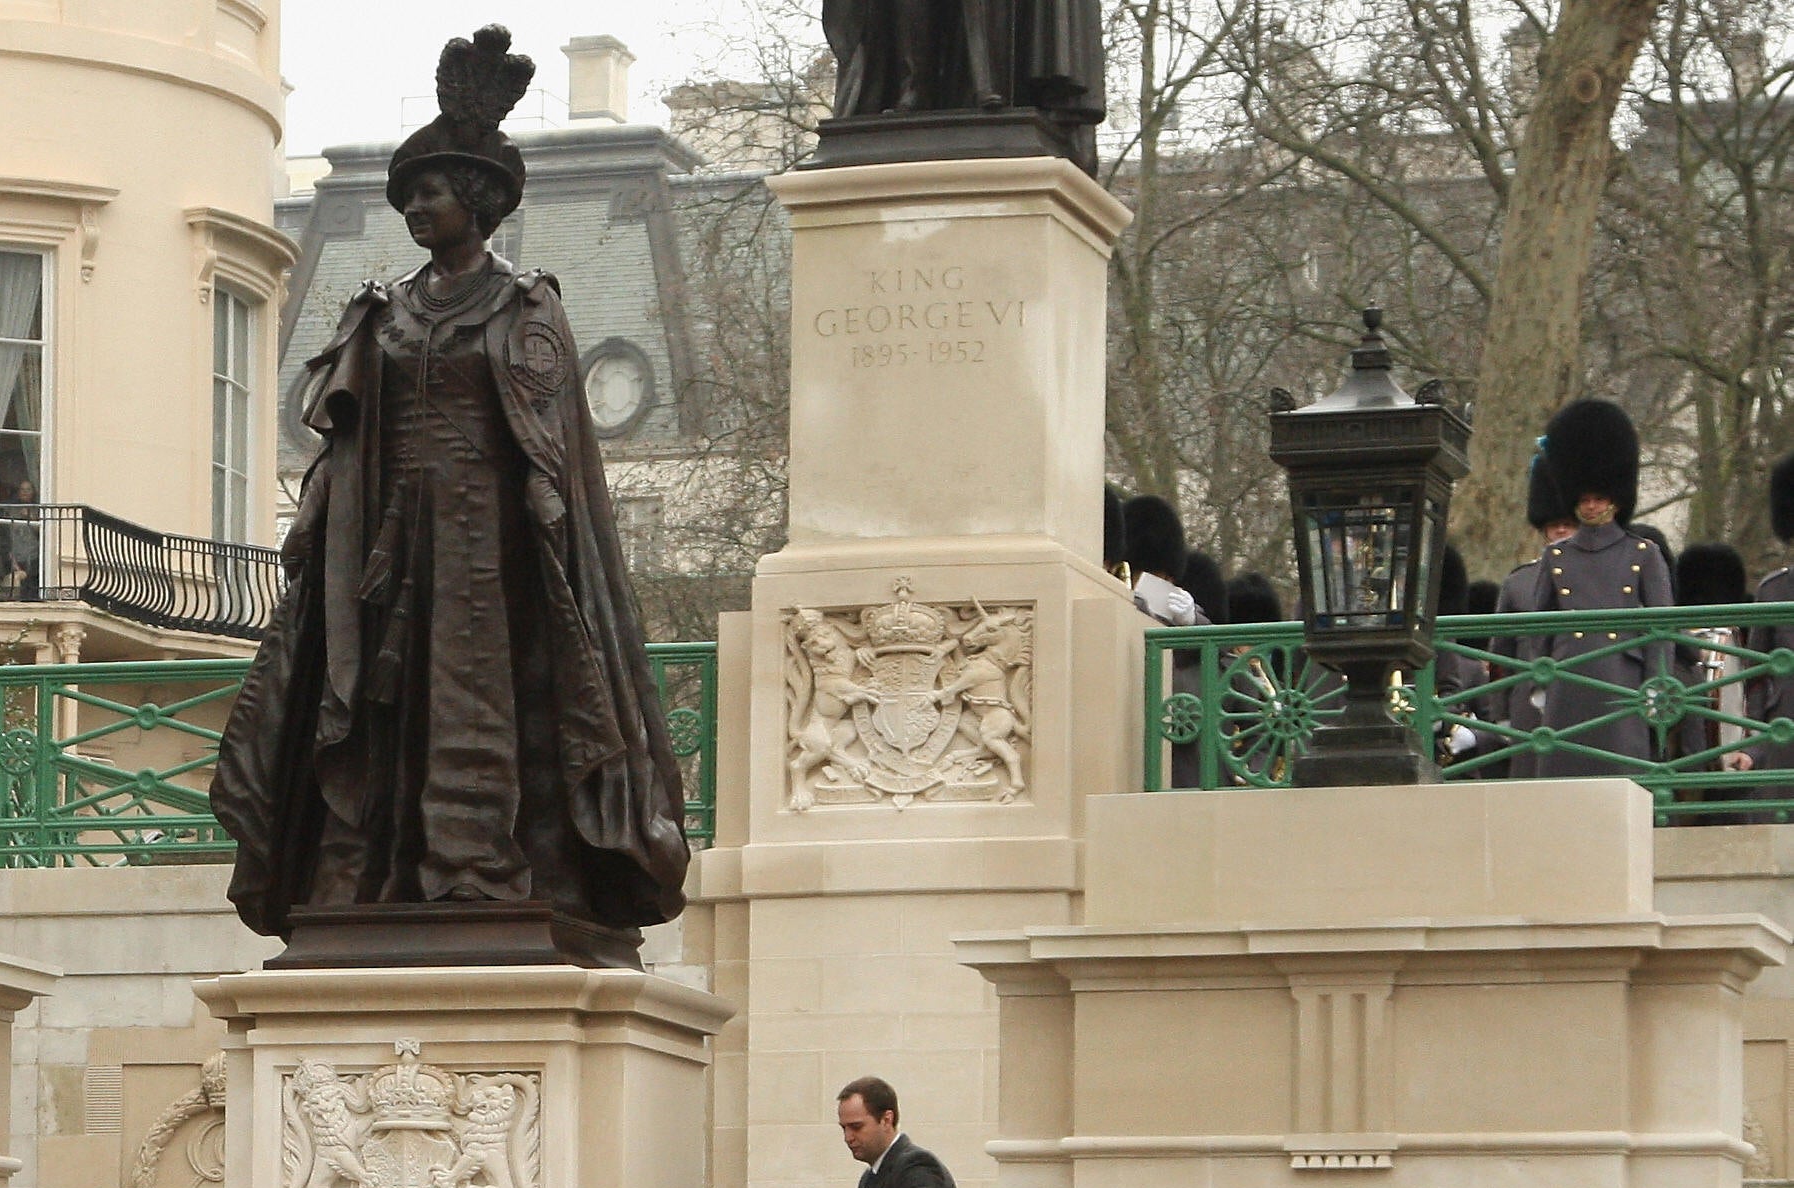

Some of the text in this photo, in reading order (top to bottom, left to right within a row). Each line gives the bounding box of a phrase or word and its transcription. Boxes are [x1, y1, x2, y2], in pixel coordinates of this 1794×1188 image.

[870, 266, 965, 294] KING
[814, 300, 1027, 338] GEORGE VI
[852, 340, 986, 368] 1895-1952
